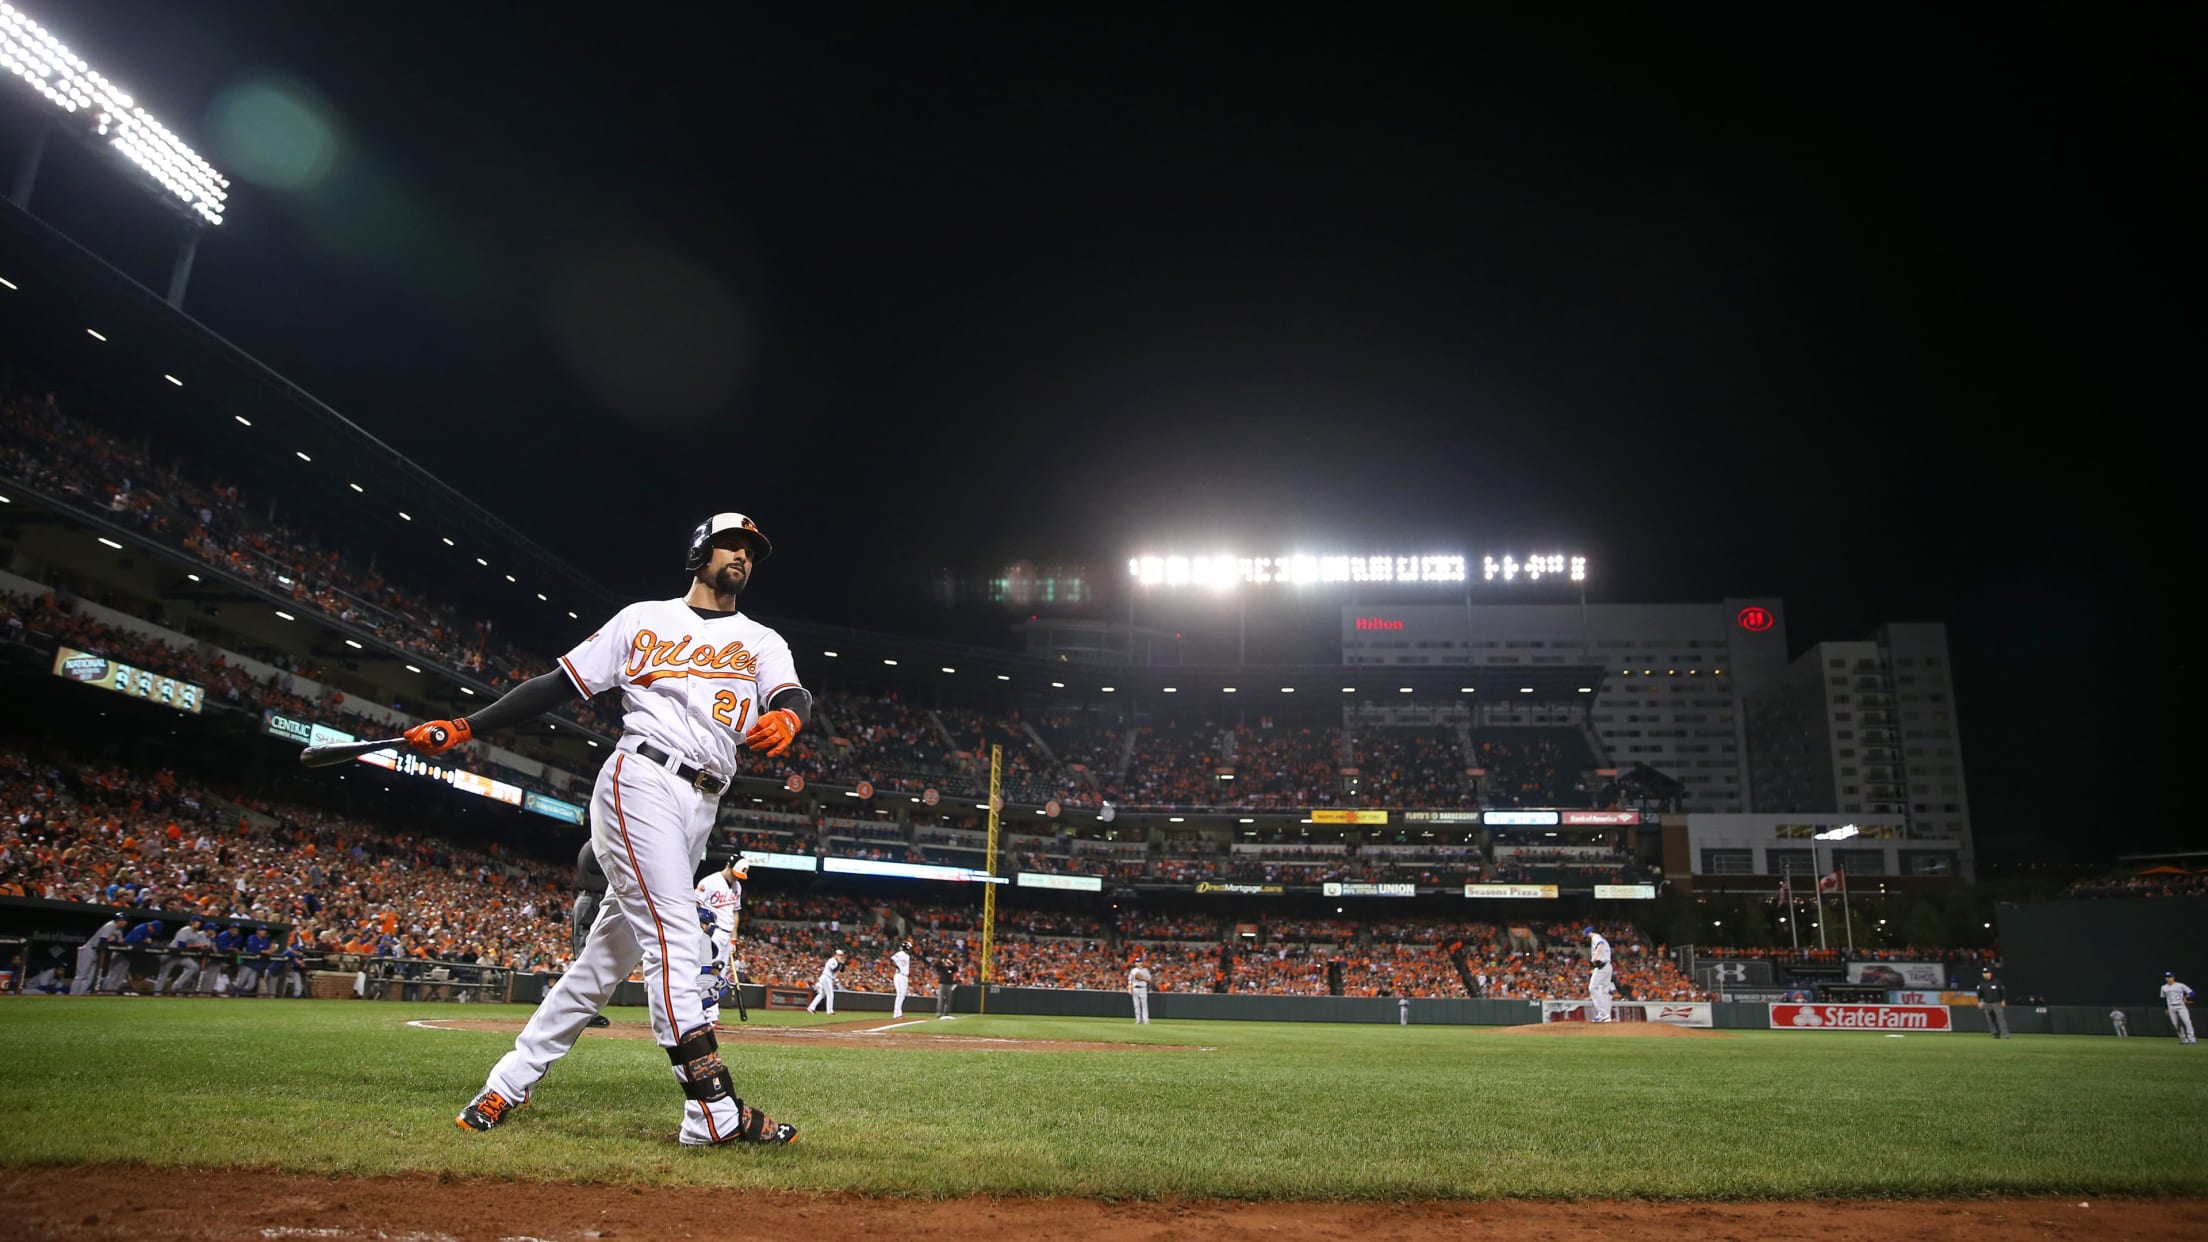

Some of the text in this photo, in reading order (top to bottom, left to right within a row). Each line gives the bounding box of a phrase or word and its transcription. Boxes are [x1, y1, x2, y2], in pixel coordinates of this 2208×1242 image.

[1355, 616, 1404, 631] Hilton
[625, 629, 758, 676] Orioles
[712, 689, 751, 732] 21
[271, 715, 311, 737] CENTRIC
[1378, 883, 1415, 894] UNION
